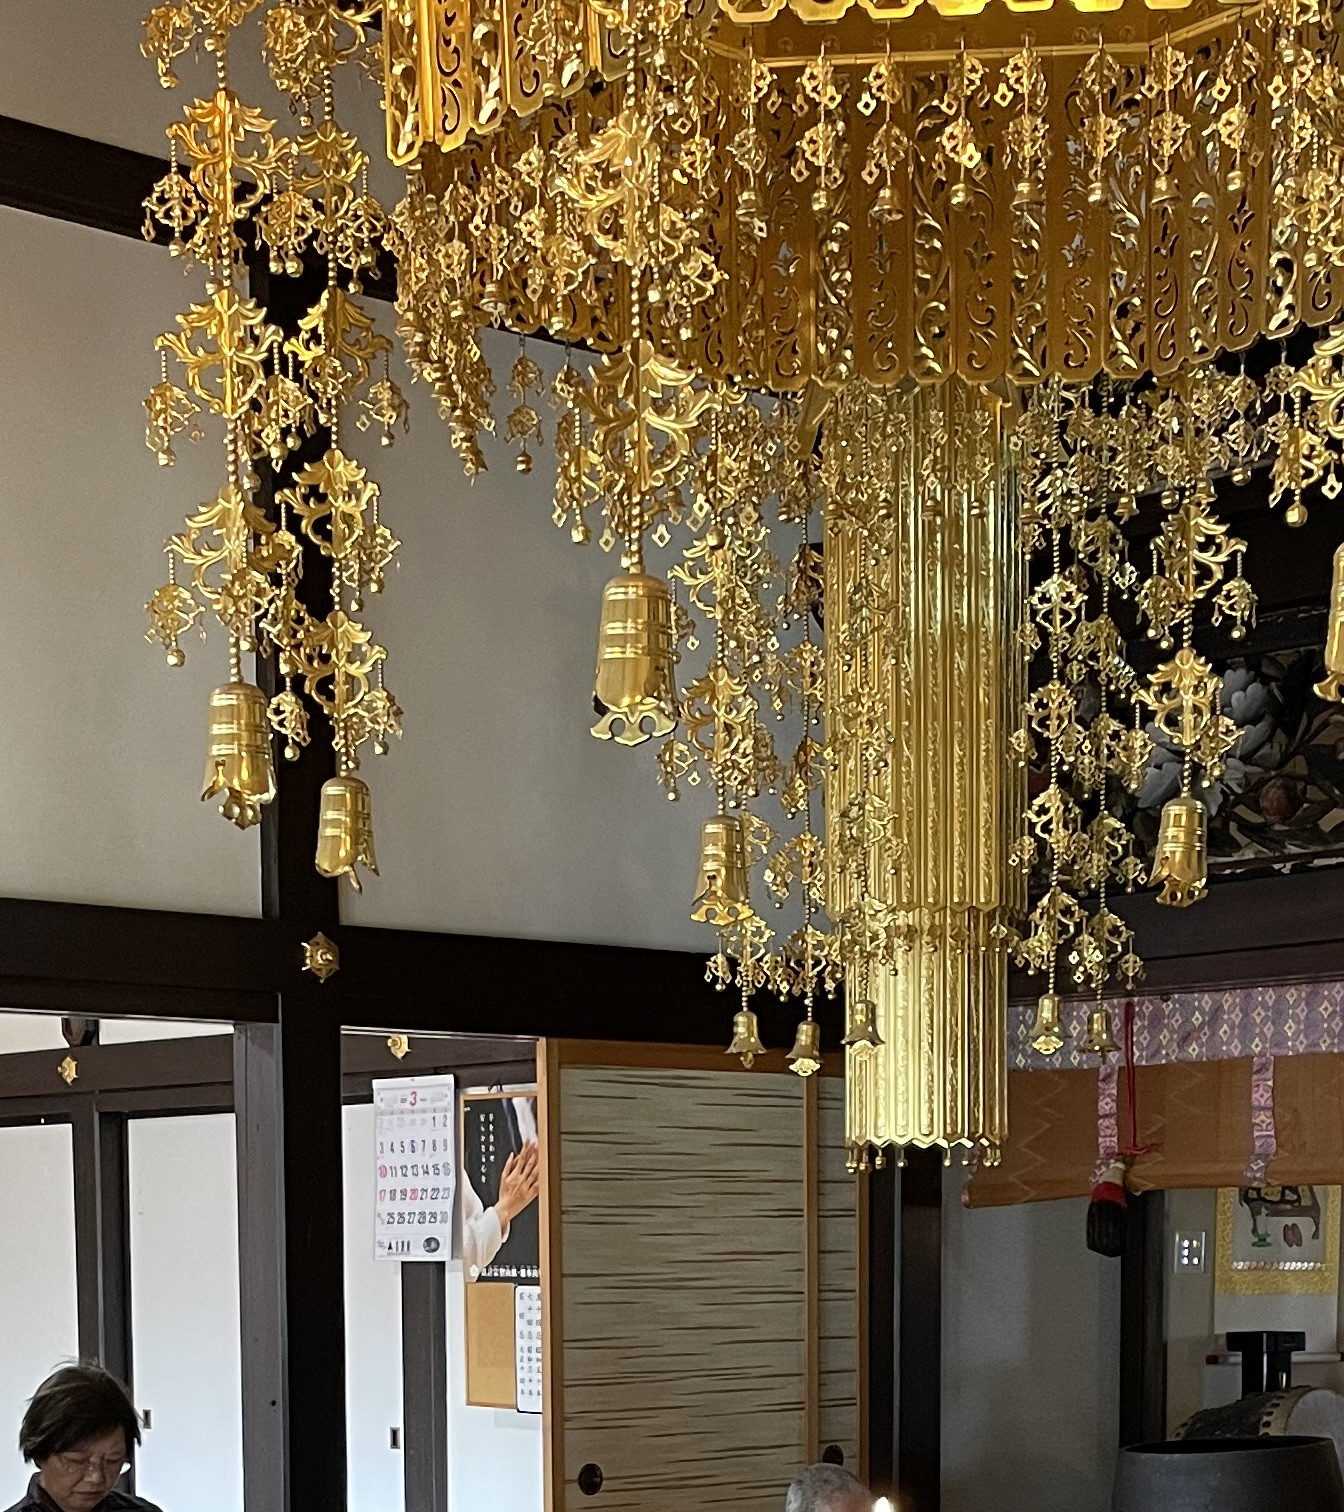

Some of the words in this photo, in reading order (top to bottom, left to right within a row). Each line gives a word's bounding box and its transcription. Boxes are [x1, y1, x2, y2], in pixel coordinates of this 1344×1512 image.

[409, 1091, 417, 1107] 3
[432, 1116, 436, 1128] 1
[443, 1114, 447, 1127] 2
[380, 1142, 384, 1153] 3
[390, 1141, 394, 1153] 4
[400, 1141, 405, 1153] 5
[410, 1140, 416, 1153] 6
[421, 1140, 426, 1153] 7
[432, 1139, 437, 1152] 8
[443, 1139, 448, 1151] 9
[379, 1164, 387, 1178] 10
[390, 1165, 397, 1178] 11
[400, 1165, 408, 1177] 12
[411, 1164, 419, 1177] 13
[421, 1164, 430, 1176] 14
[432, 1163, 440, 1176] 15
[379, 1189, 386, 1201] 17
[400, 1189, 407, 1201] 19
[420, 1188, 428, 1200] 21
[430, 1188, 440, 1200] 22
[442, 1187, 450, 1200] 23
[387, 1212, 395, 1224] 25
[397, 1212, 405, 1224] 26
[408, 1212, 416, 1224] 27
[428, 1211, 437, 1224] 29
